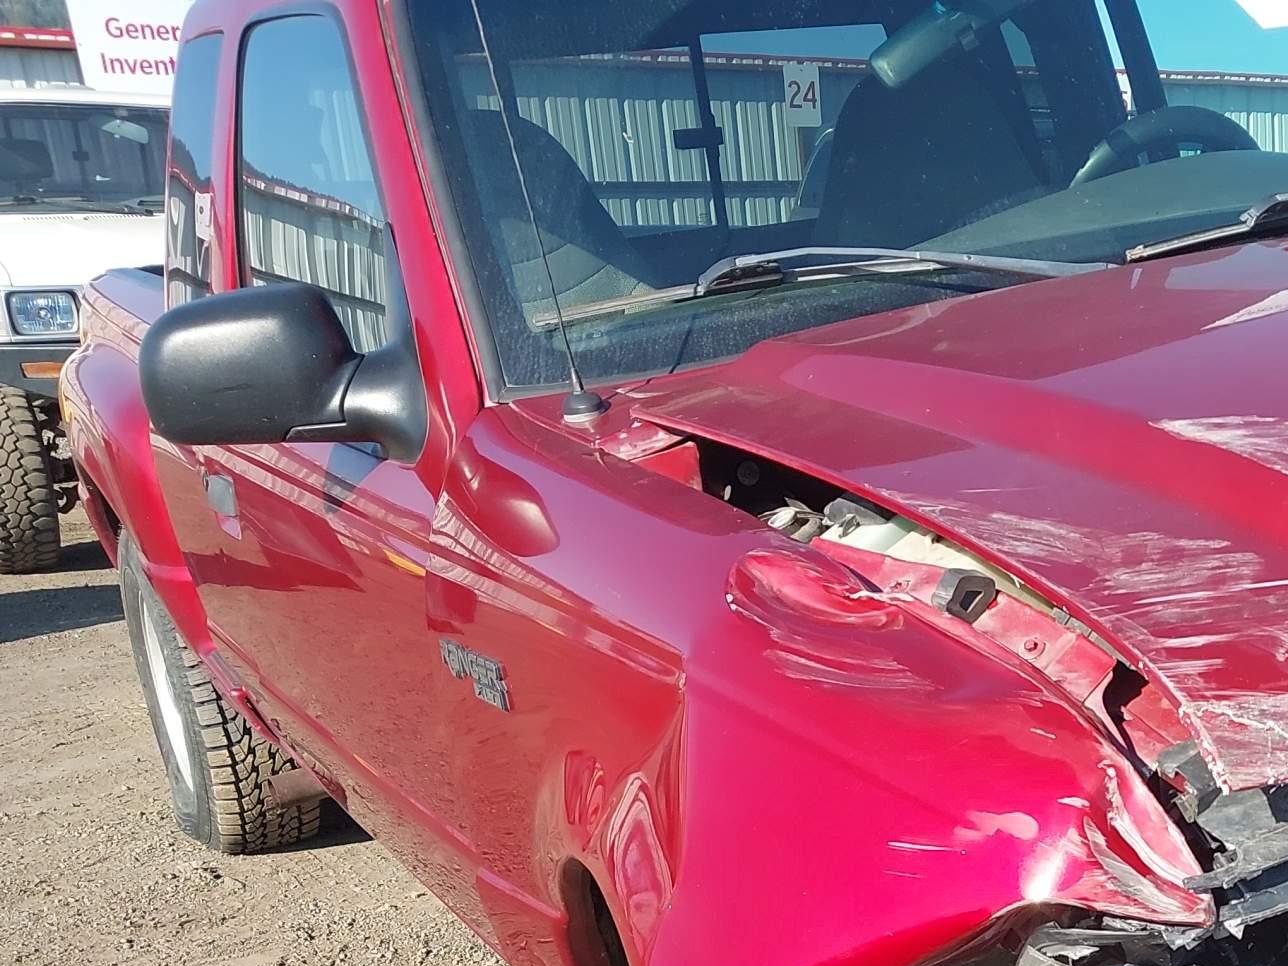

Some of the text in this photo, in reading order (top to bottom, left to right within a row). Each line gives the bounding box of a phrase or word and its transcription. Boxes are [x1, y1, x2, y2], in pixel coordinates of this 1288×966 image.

[105, 17, 181, 42] Gener
[100, 52, 176, 76] Invent
[787, 80, 818, 109] 24
